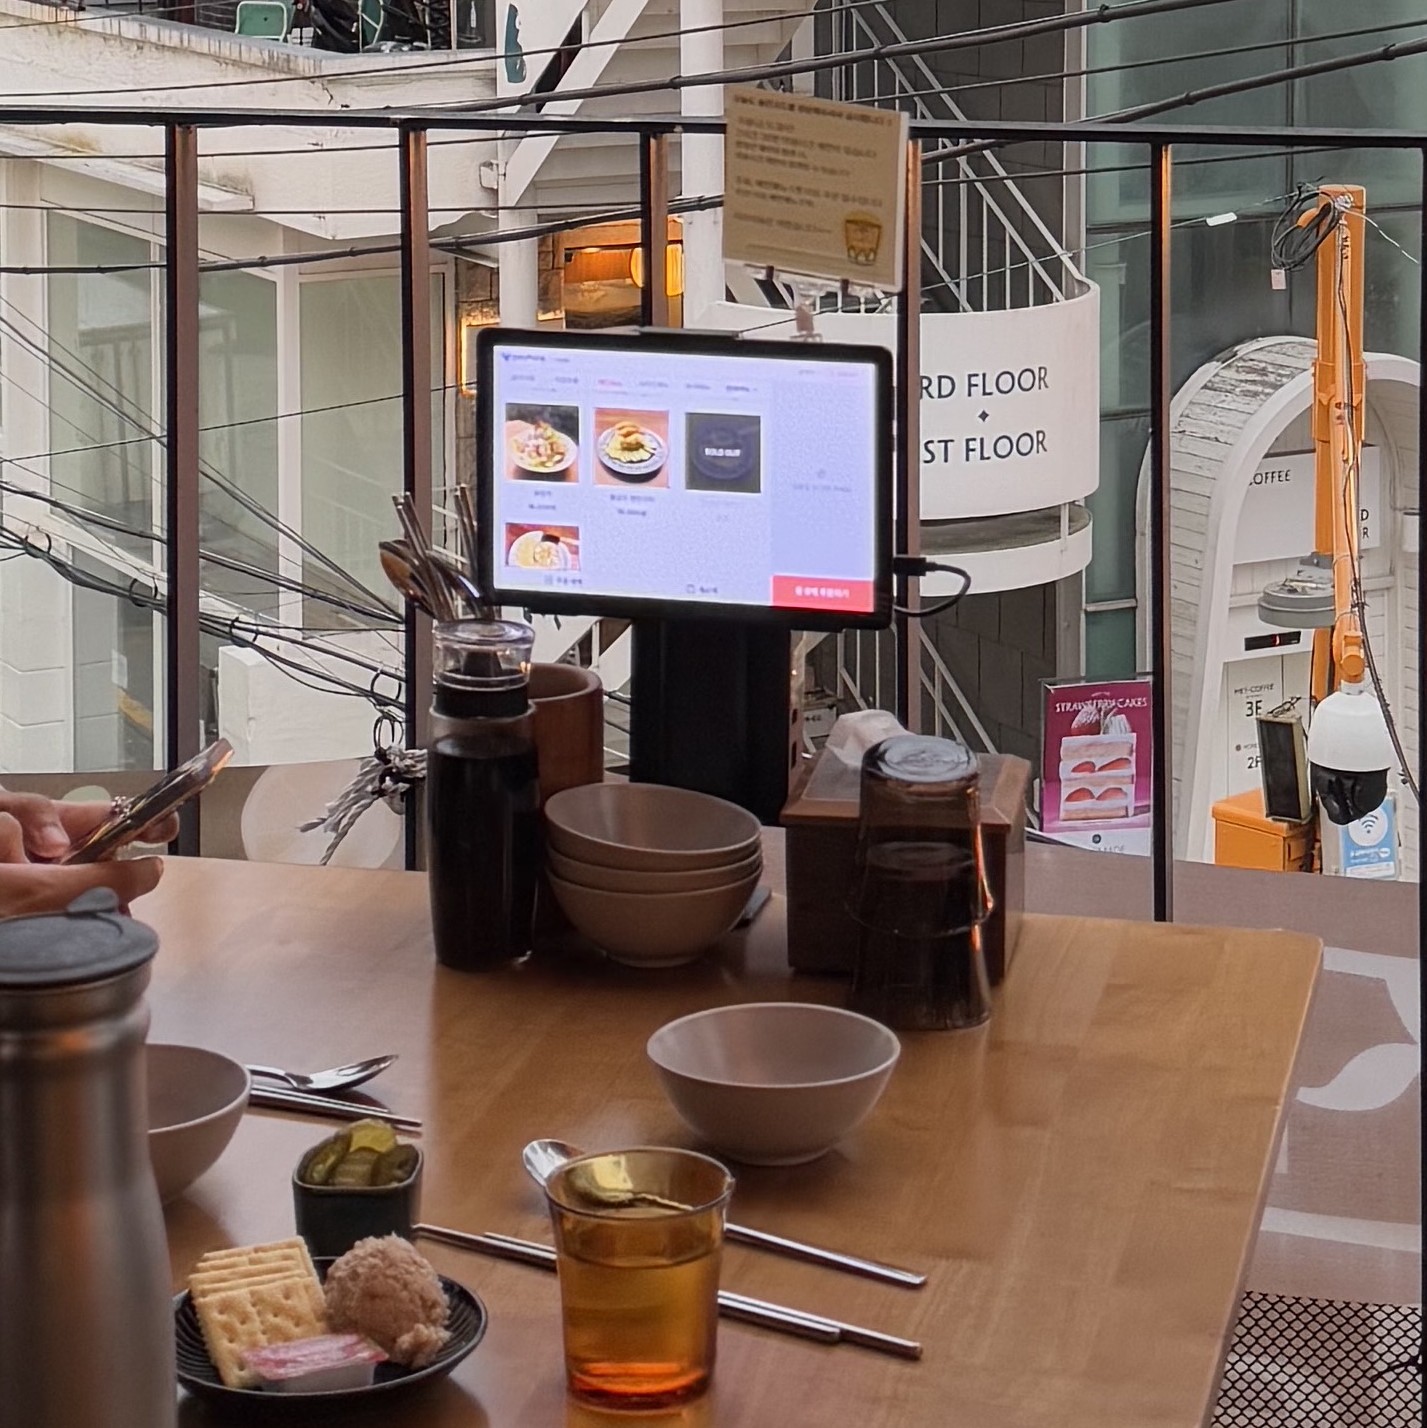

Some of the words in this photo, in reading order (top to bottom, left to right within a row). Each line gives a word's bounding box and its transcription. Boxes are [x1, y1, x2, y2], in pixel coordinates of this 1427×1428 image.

[920, 375, 956, 400] RD
[967, 366, 1049, 397] FLOOR
[922, 439, 955, 464] ST
[965, 429, 1048, 462] FLOOR
[1249, 469, 1291, 486] OFFEE
